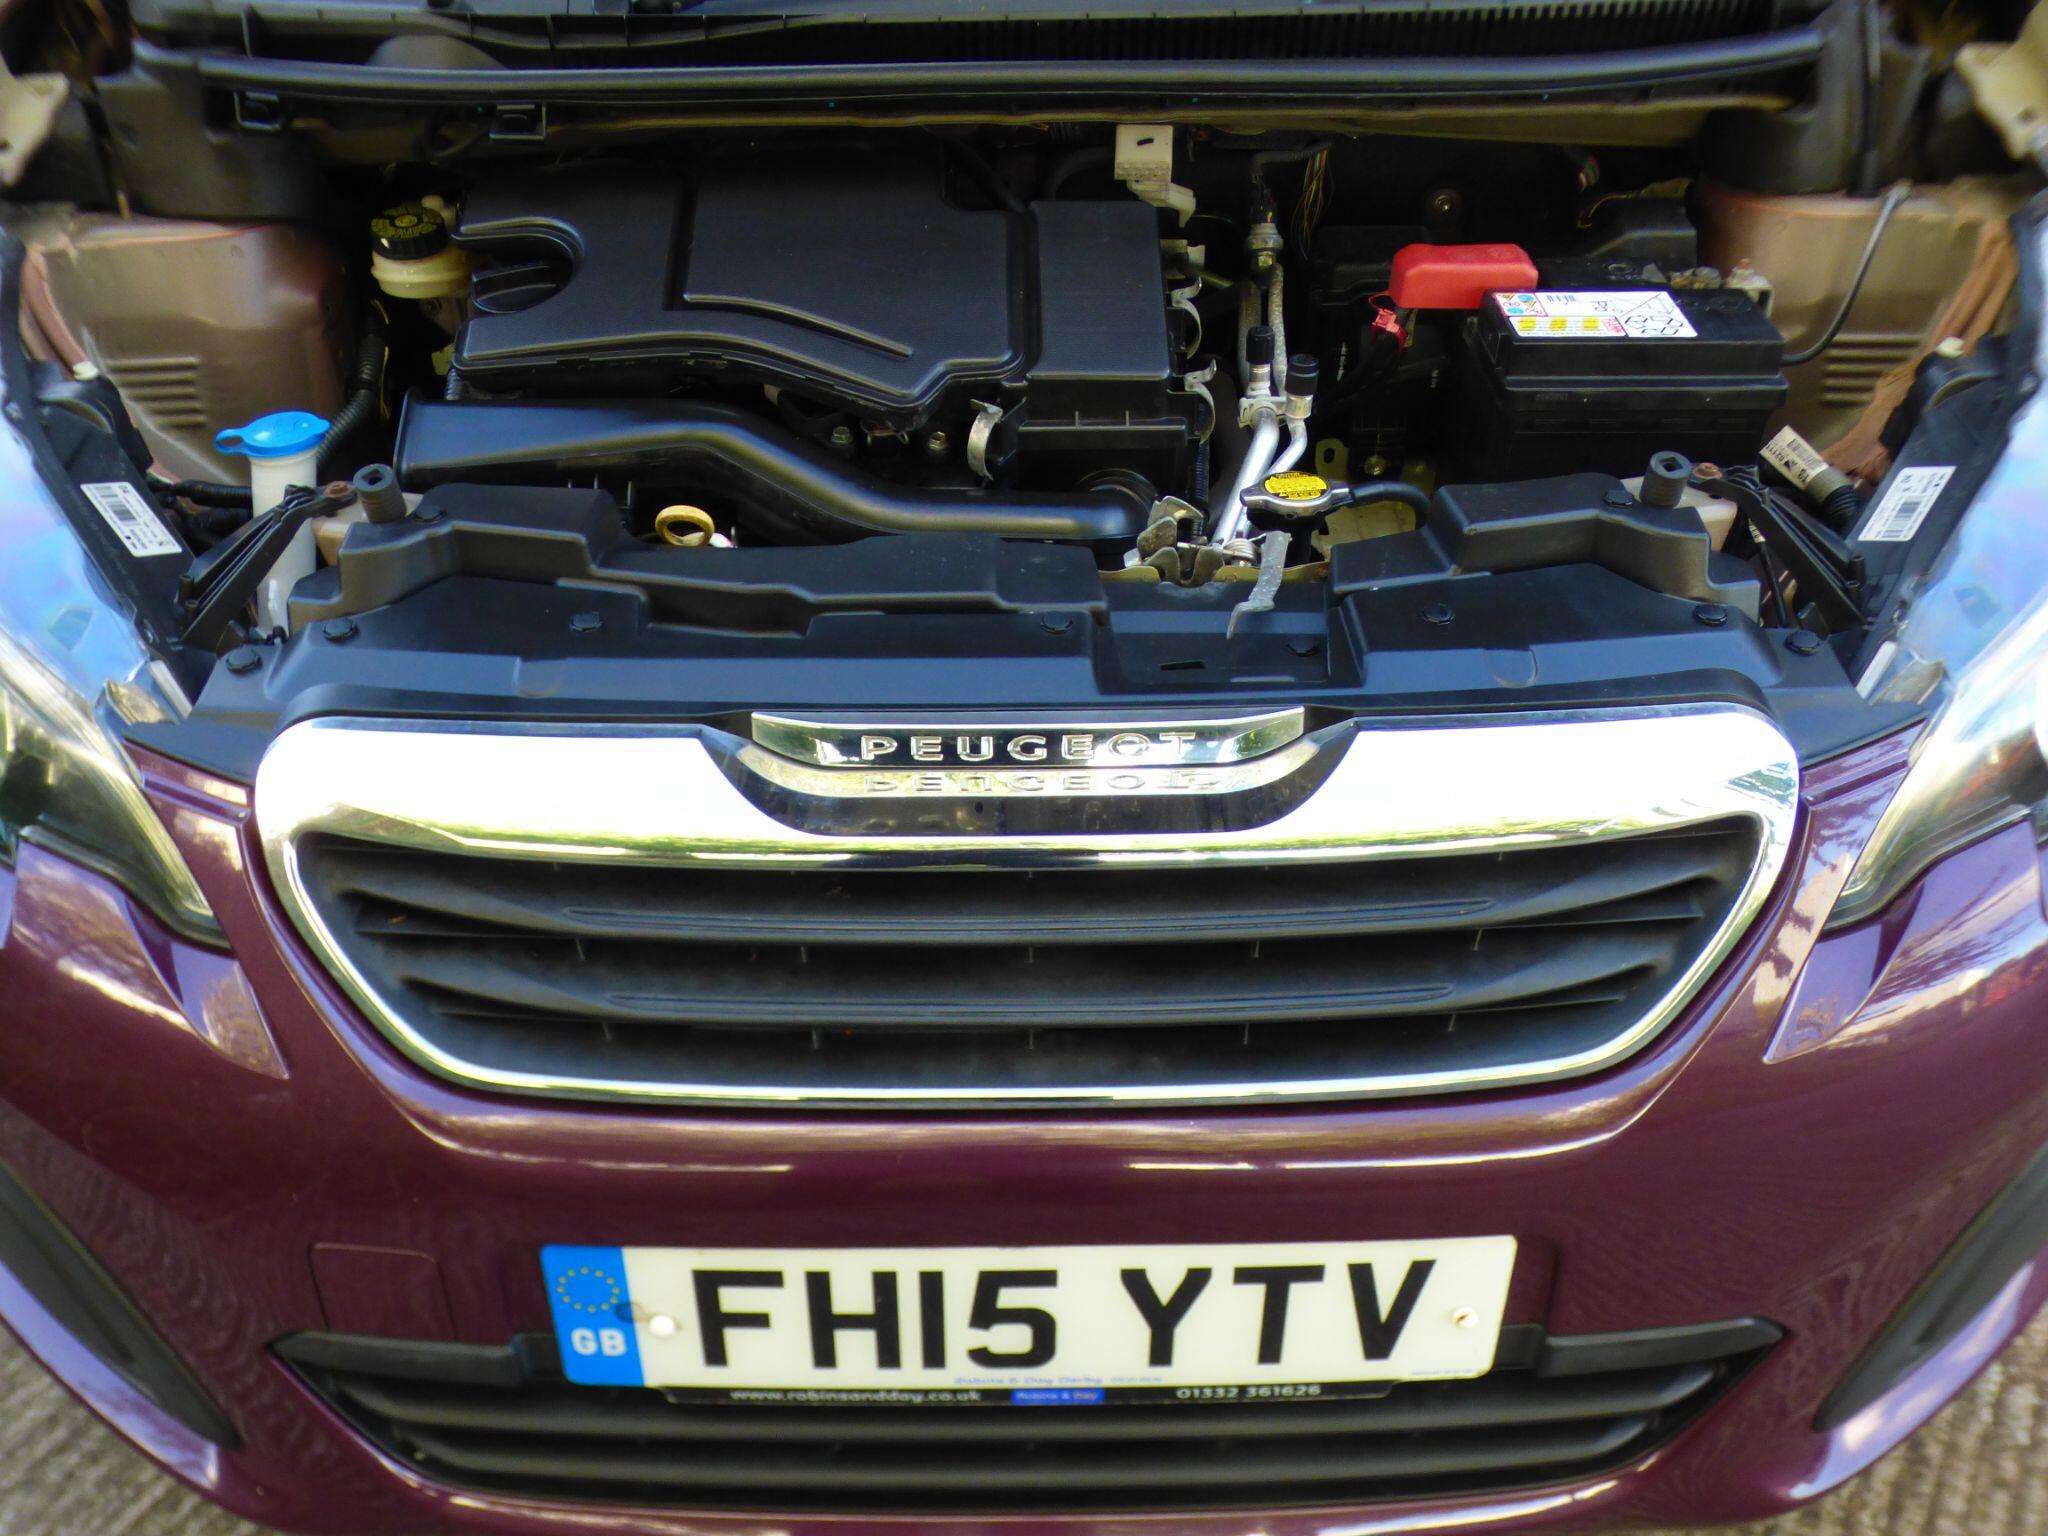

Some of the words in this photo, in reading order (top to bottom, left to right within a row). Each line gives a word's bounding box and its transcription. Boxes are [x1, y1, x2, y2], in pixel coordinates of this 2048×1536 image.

[861, 732, 1196, 761] PEUGEOT
[692, 1269, 1058, 1369] FH15
[1120, 1260, 1437, 1367] YTV
[570, 1328, 626, 1356] GB
[1176, 1386, 1239, 1399] 01332
